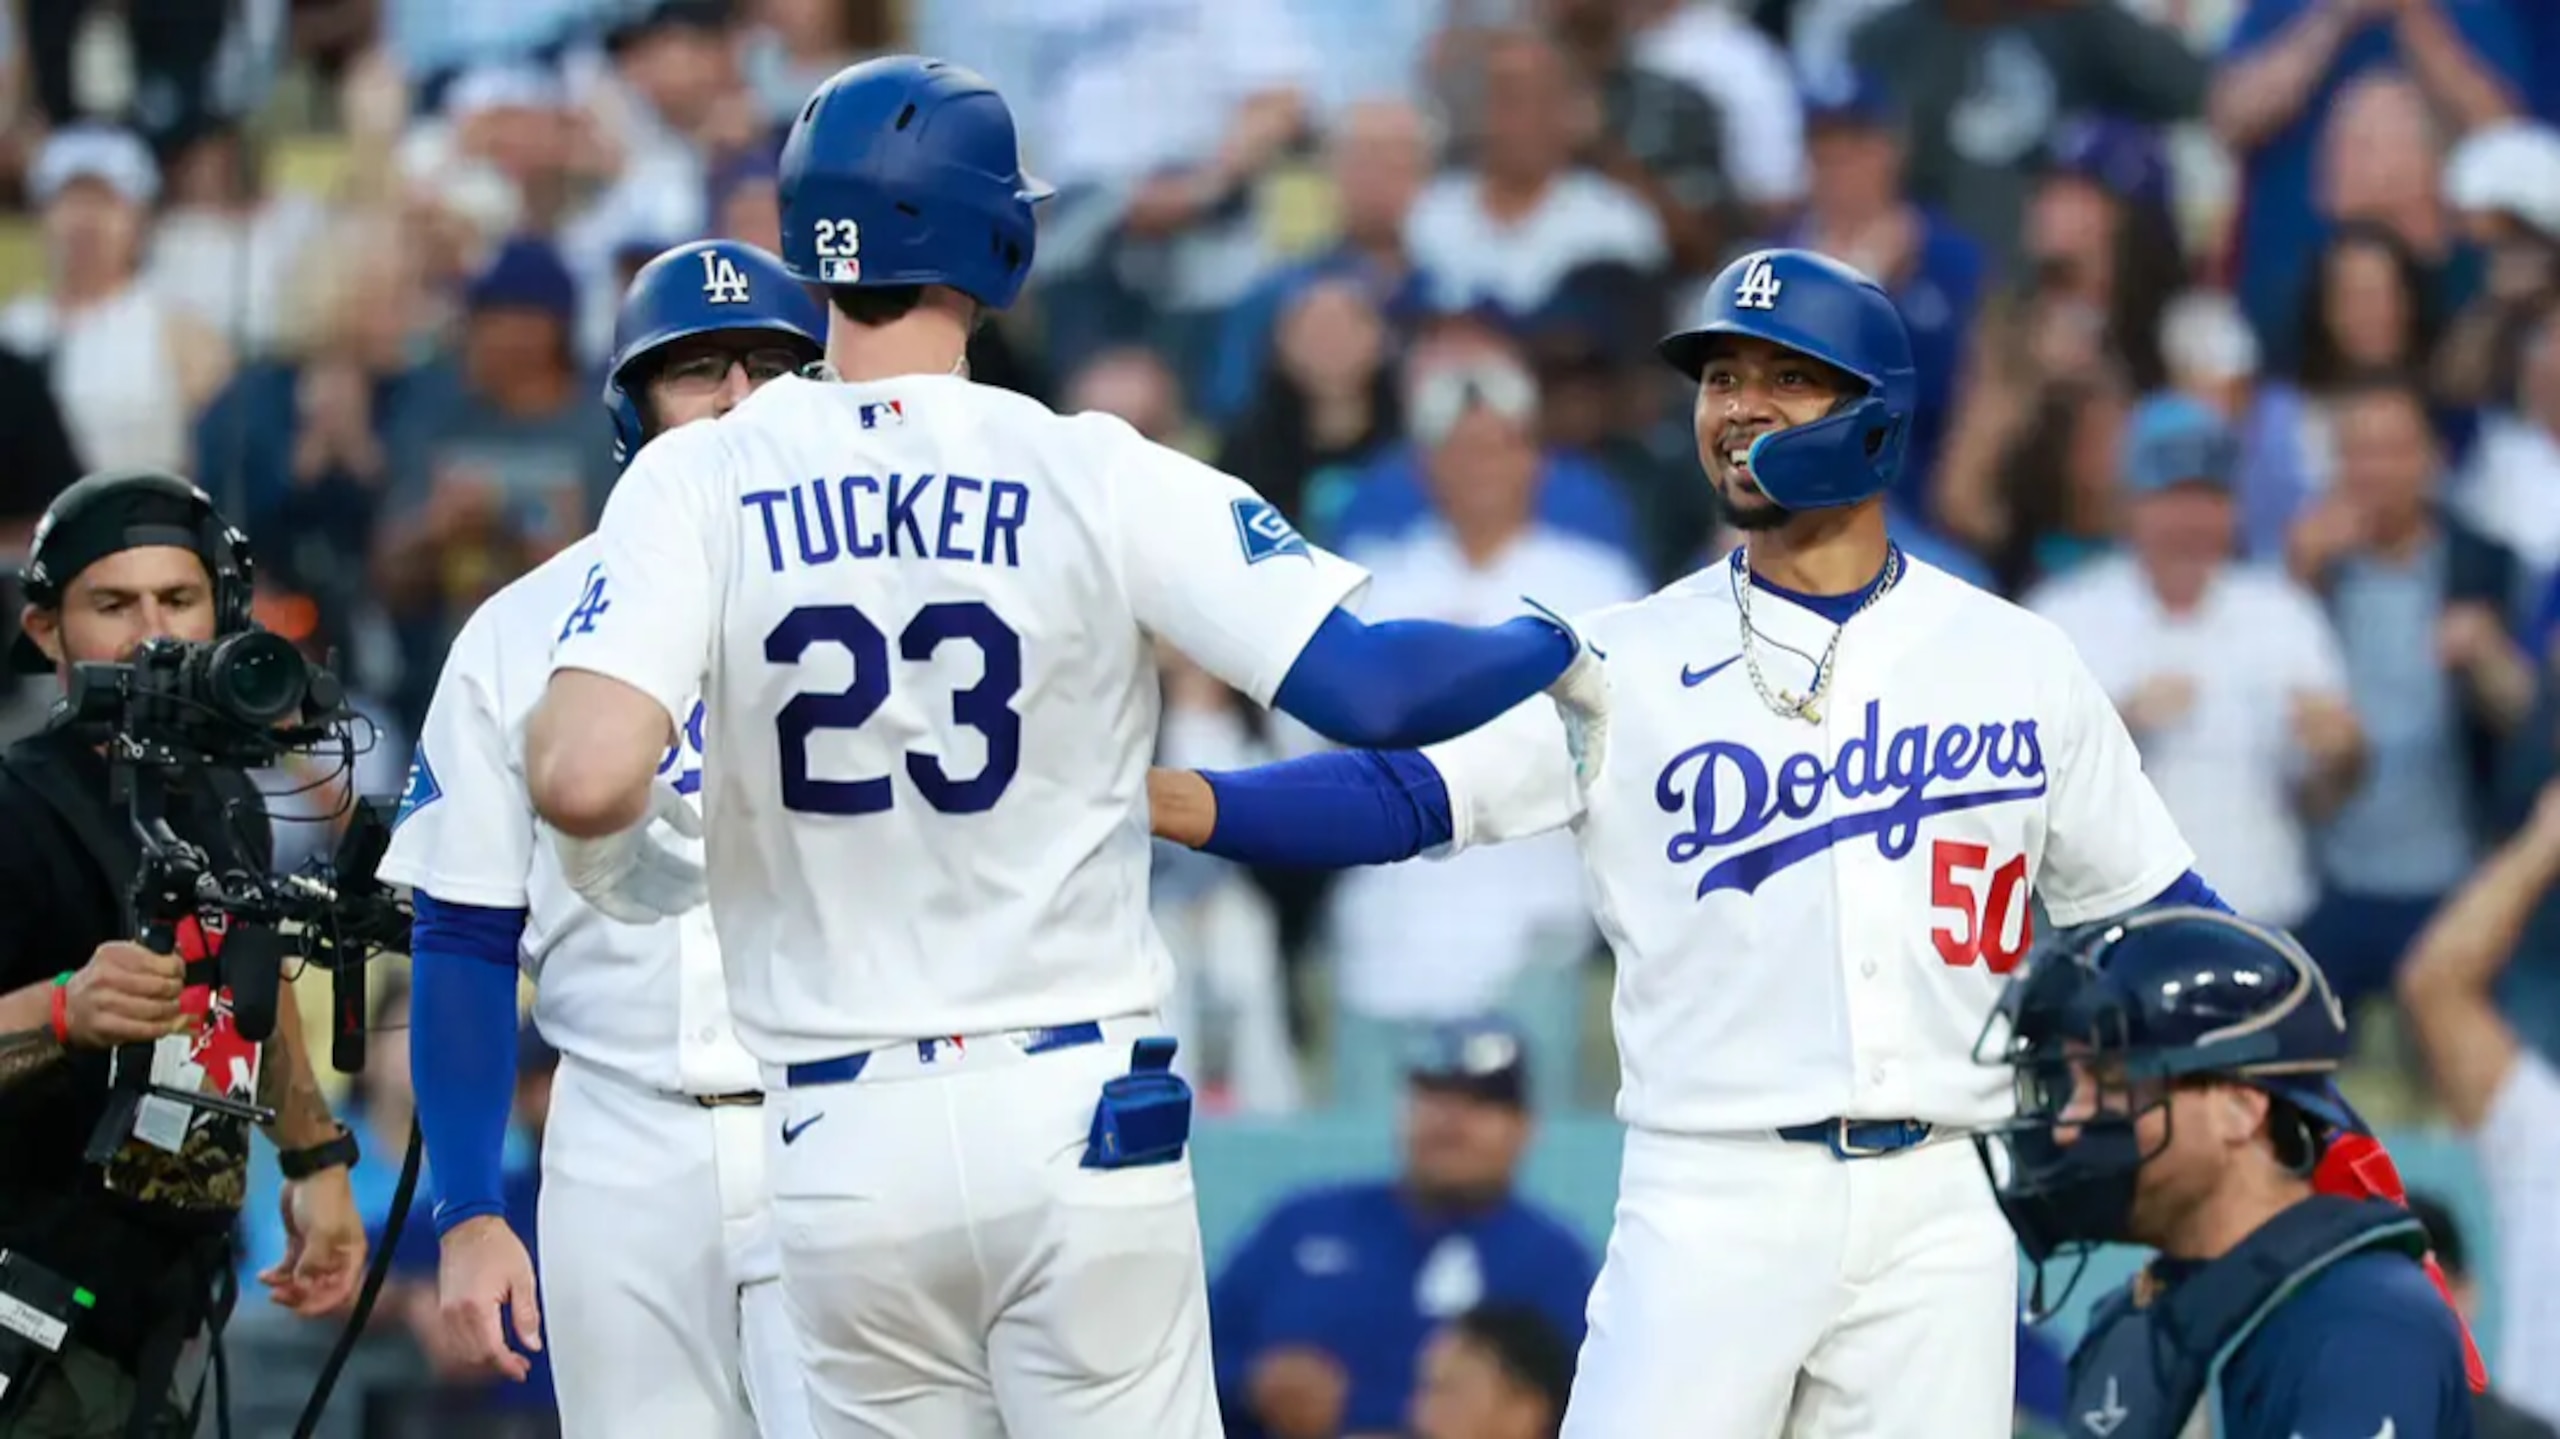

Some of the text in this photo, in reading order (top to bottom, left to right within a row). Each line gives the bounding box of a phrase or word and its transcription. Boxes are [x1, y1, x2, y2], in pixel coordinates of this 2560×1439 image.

[698, 249, 750, 303] LA
[814, 218, 859, 256] 23
[1734, 255, 1782, 310] LA
[741, 473, 1030, 573] TUCKER
[764, 600, 1022, 815] 23
[1656, 698, 2045, 864] Dodgers
[1931, 838, 2034, 975] 50
